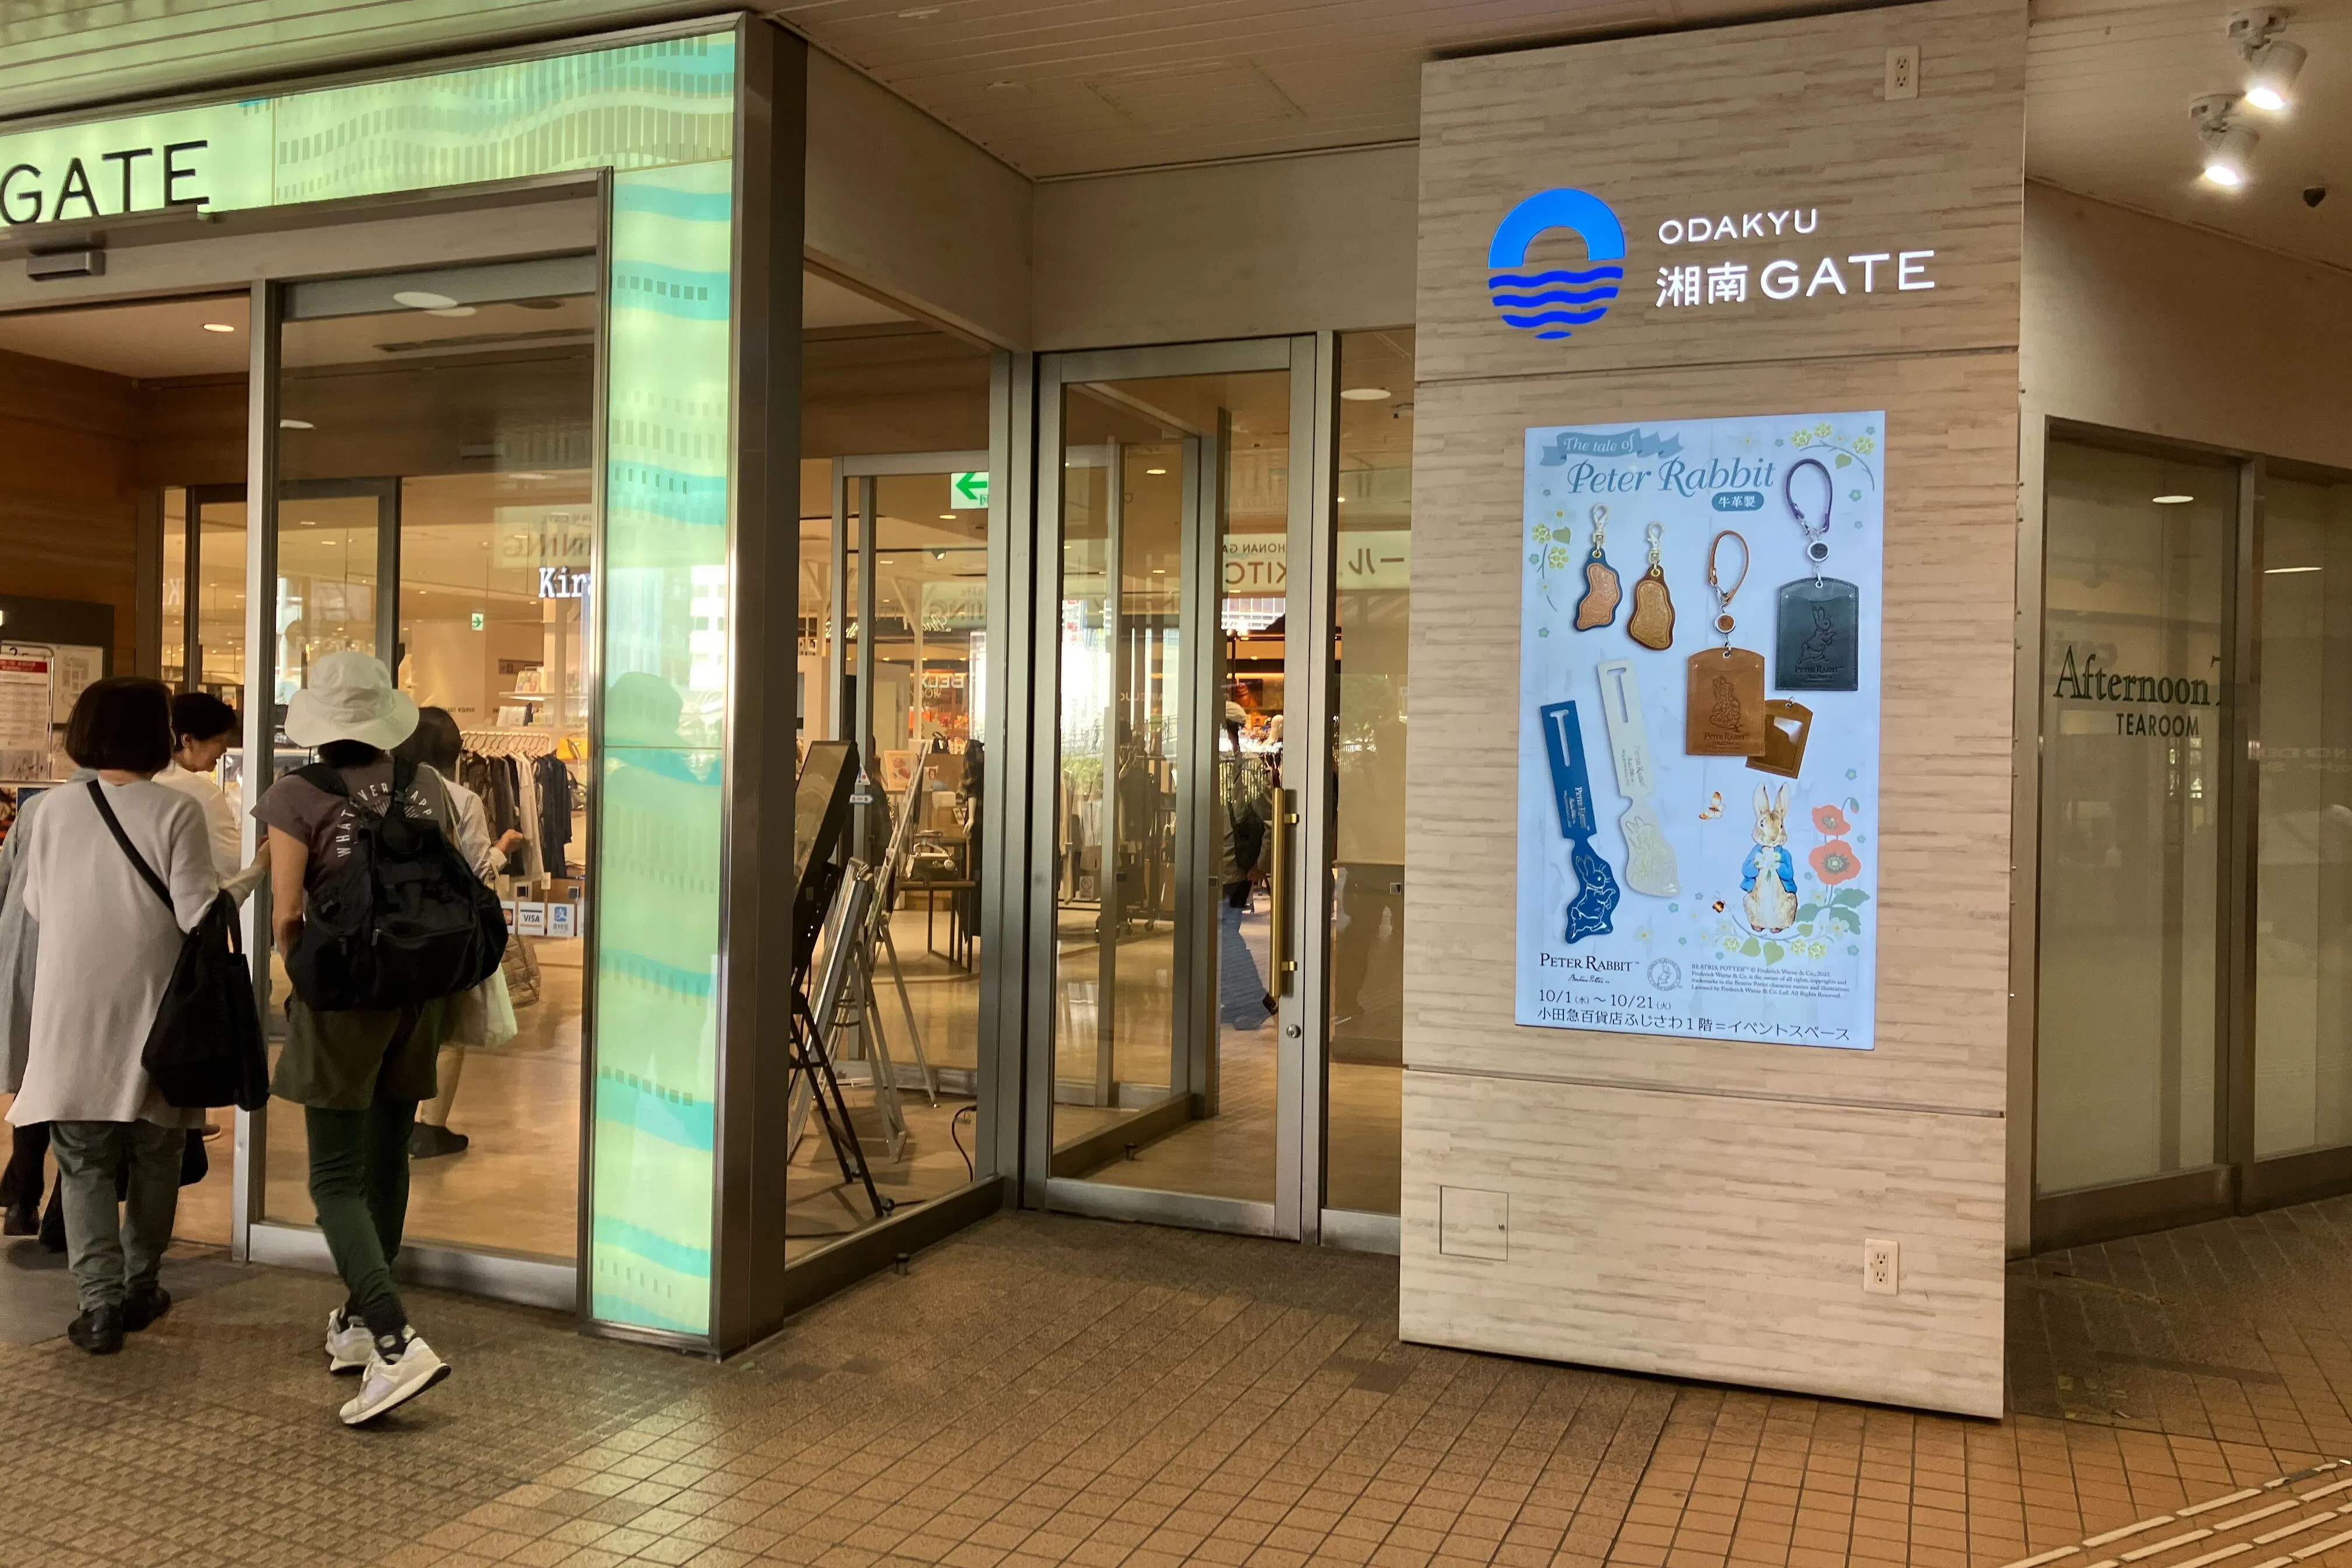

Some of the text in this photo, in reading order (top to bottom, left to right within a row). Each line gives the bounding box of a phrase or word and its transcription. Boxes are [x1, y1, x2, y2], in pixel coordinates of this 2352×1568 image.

[0, 140, 210, 225] GATE
[1658, 208, 1818, 244] ODAKYU
[1656, 250, 1935, 307] 湘南 GATE
[1563, 434, 1634, 452] The tale of
[1567, 456, 1776, 497] Peter Rabbit
[1718, 495, 1755, 508] 牛革製
[538, 566, 591, 598] Kir
[2053, 644, 2210, 706] Afternoon
[2116, 713, 2199, 737] TEAROOM
[524, 914, 540, 923] VISA
[1540, 953, 1583, 969] PETER
